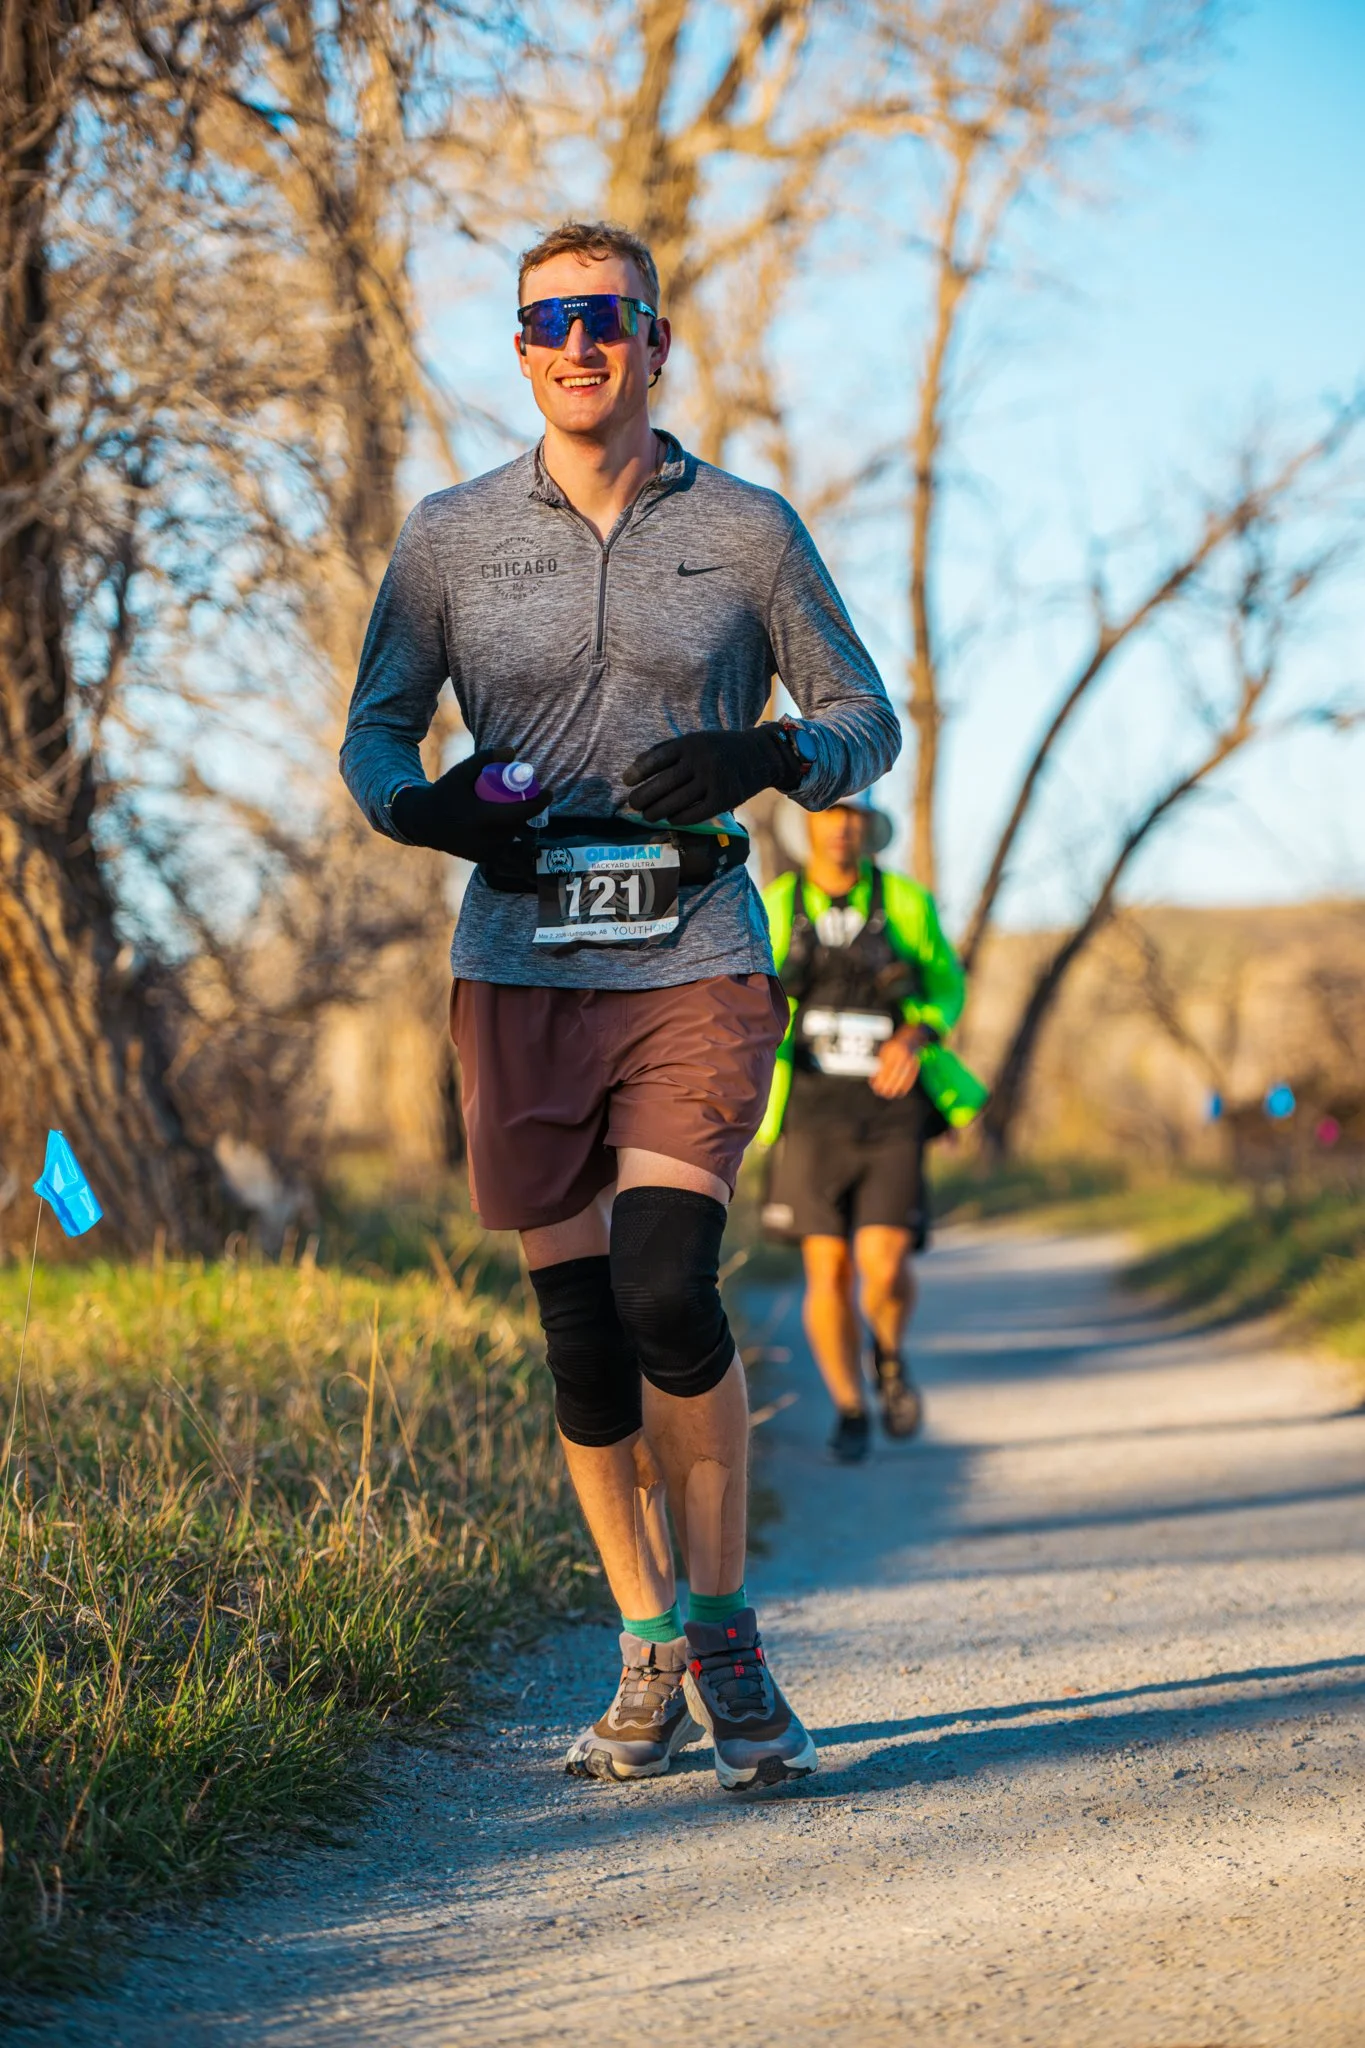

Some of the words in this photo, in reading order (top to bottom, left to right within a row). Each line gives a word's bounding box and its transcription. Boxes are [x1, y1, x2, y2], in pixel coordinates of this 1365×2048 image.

[481, 558, 557, 579] CHICAGO
[586, 846, 661, 861] OLDMAN
[591, 862, 630, 870] BACKYARD
[566, 874, 640, 917] 121
